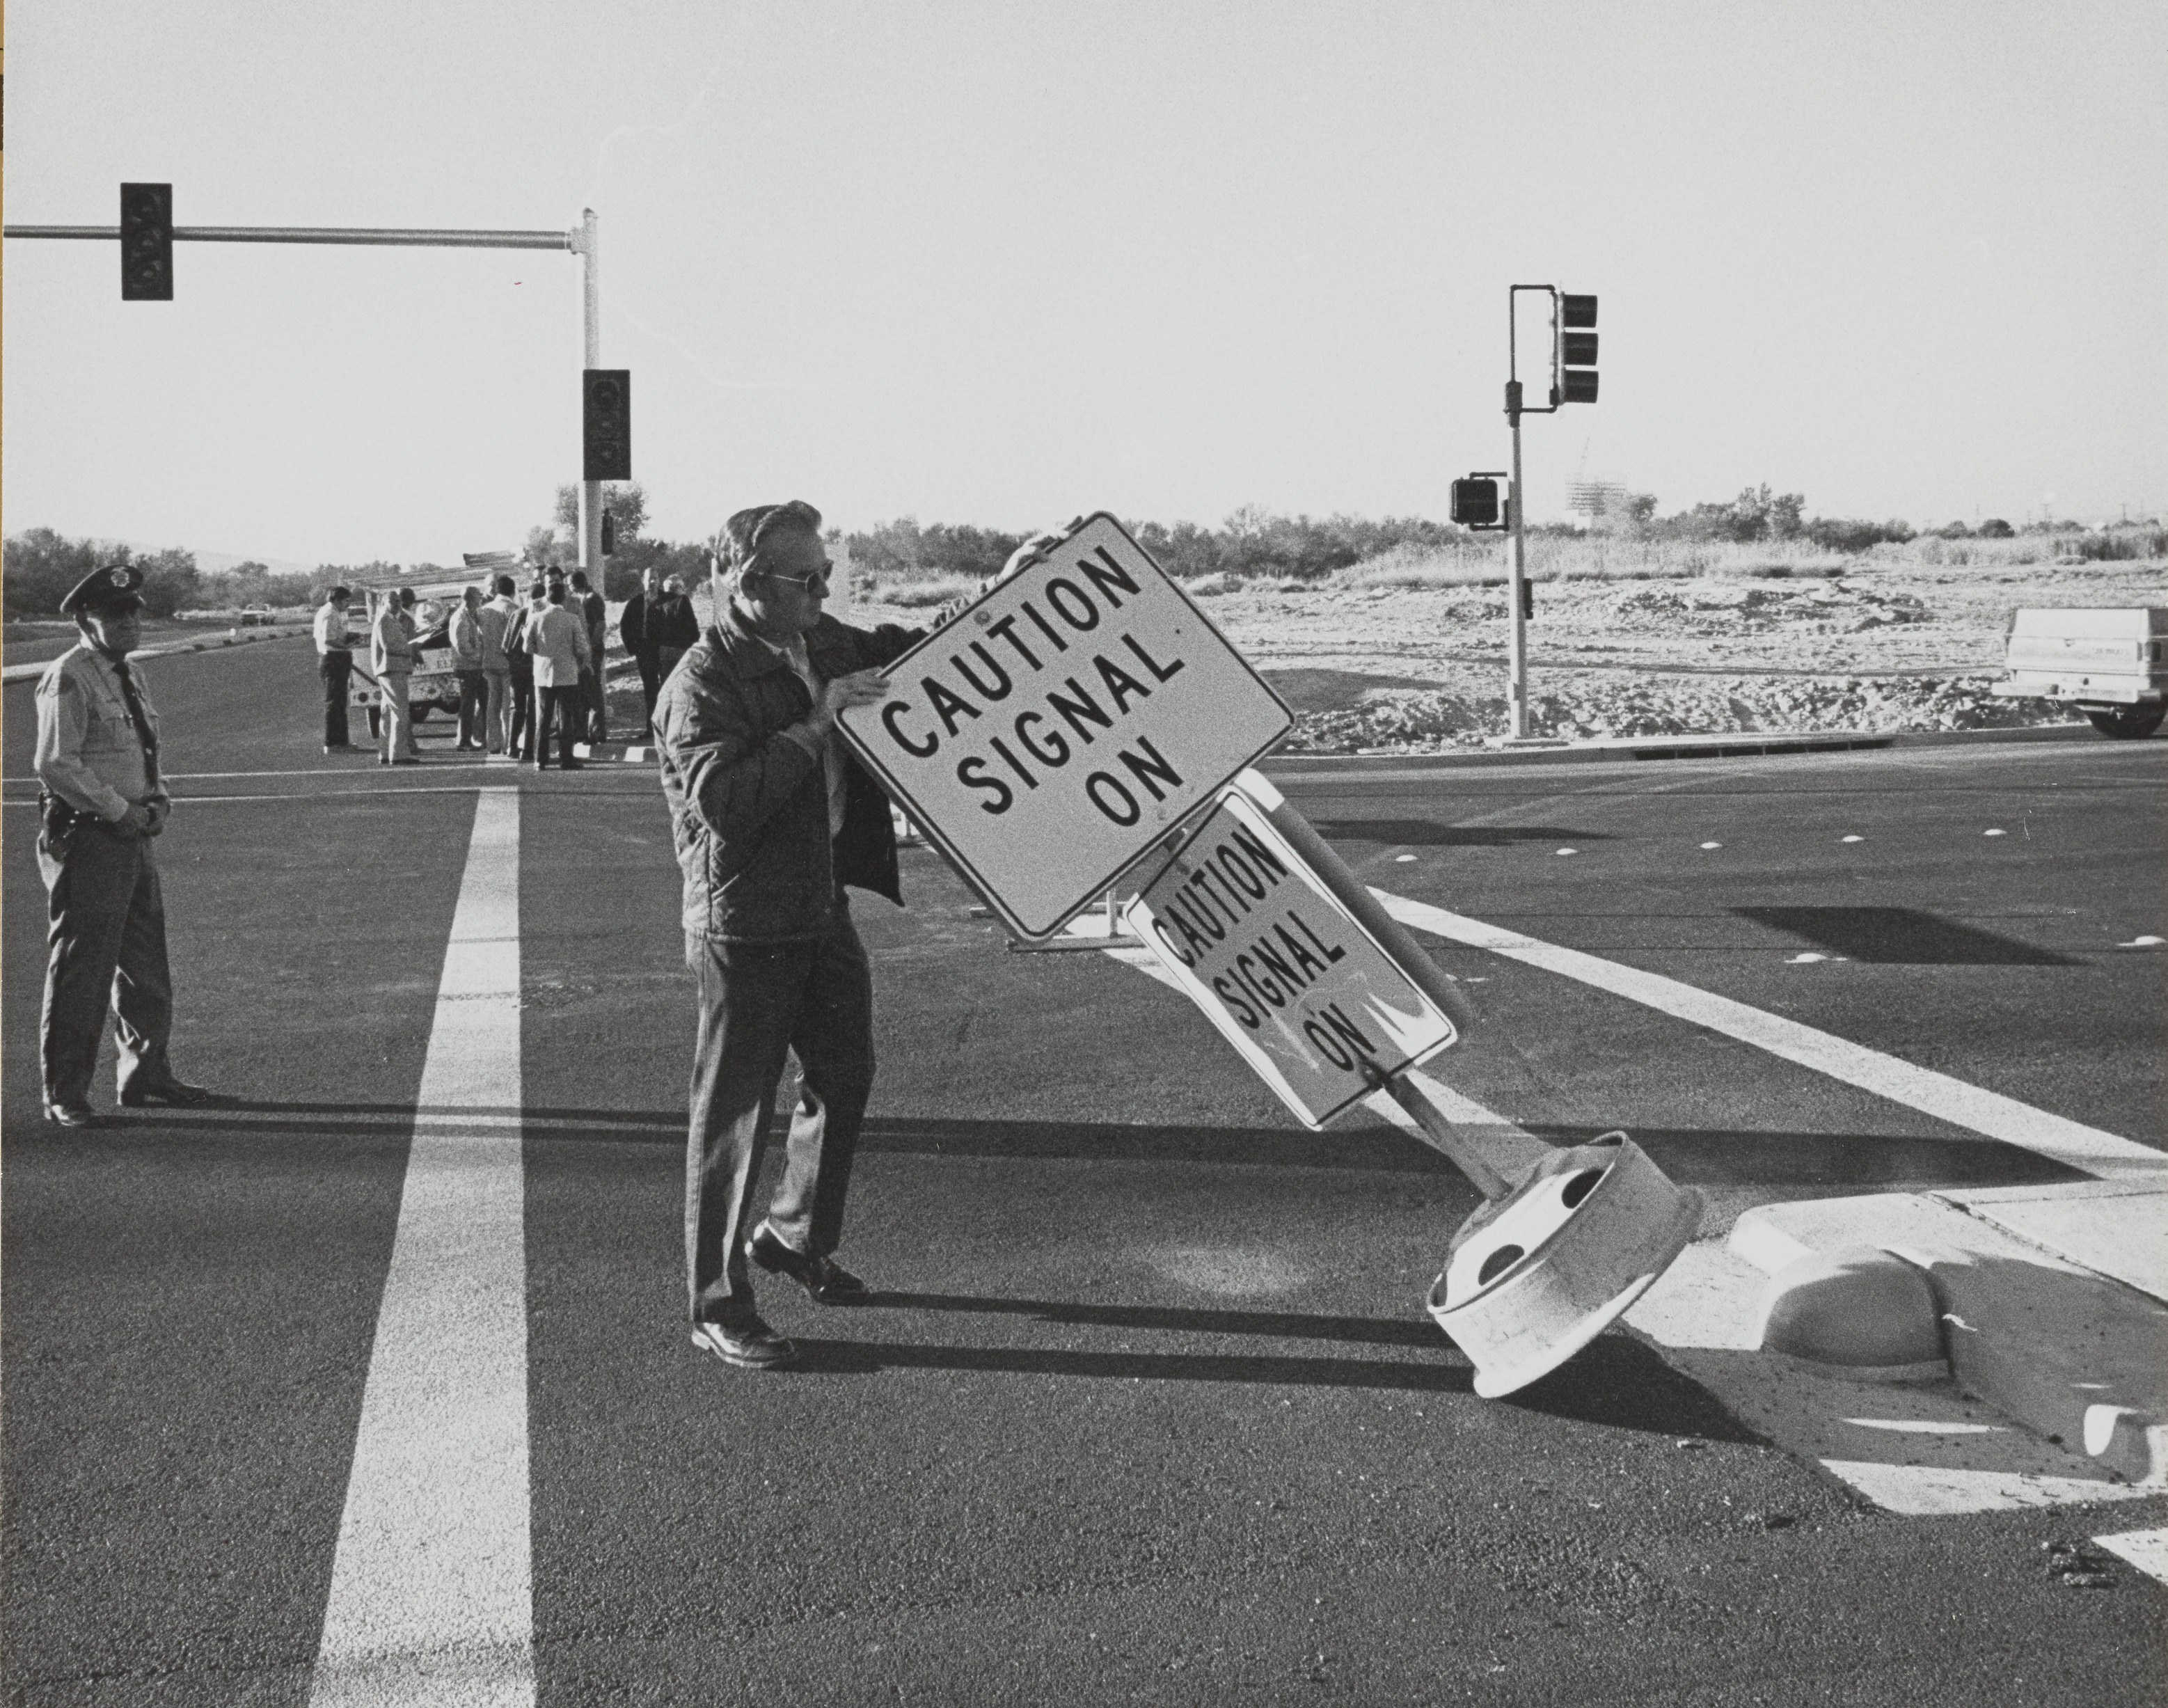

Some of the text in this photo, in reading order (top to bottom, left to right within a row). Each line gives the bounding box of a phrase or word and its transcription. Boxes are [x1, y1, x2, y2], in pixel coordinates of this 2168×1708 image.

[881, 545, 1141, 759] CAUTION
[956, 633, 1185, 814] SIGNAL
[1086, 736, 1183, 827] ON
[1150, 822, 1288, 968] CAUTION
[1212, 910, 1346, 1029] SIGNAL
[1302, 1002, 1377, 1072] ON
